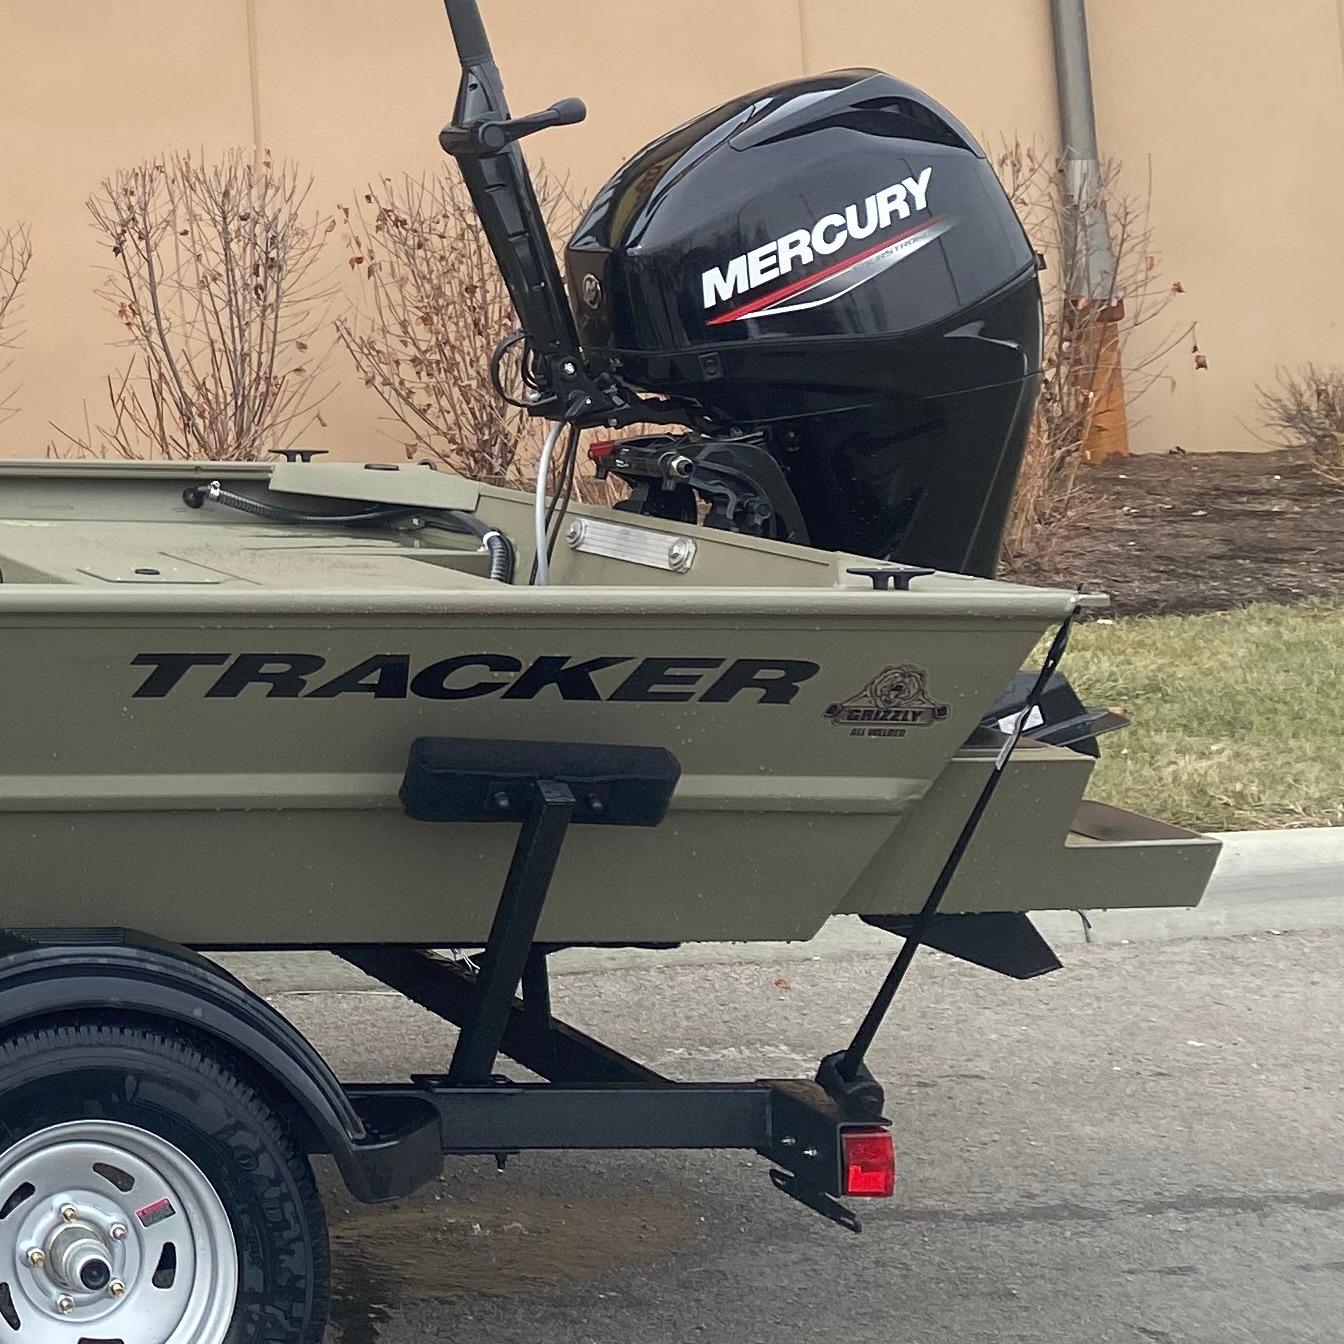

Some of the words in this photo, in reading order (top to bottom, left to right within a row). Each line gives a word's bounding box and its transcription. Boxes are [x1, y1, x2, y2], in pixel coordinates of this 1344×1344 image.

[701, 167, 932, 309] MERCURY
[126, 653, 822, 705] TRACKER
[846, 709, 923, 722] GRIZZLY
